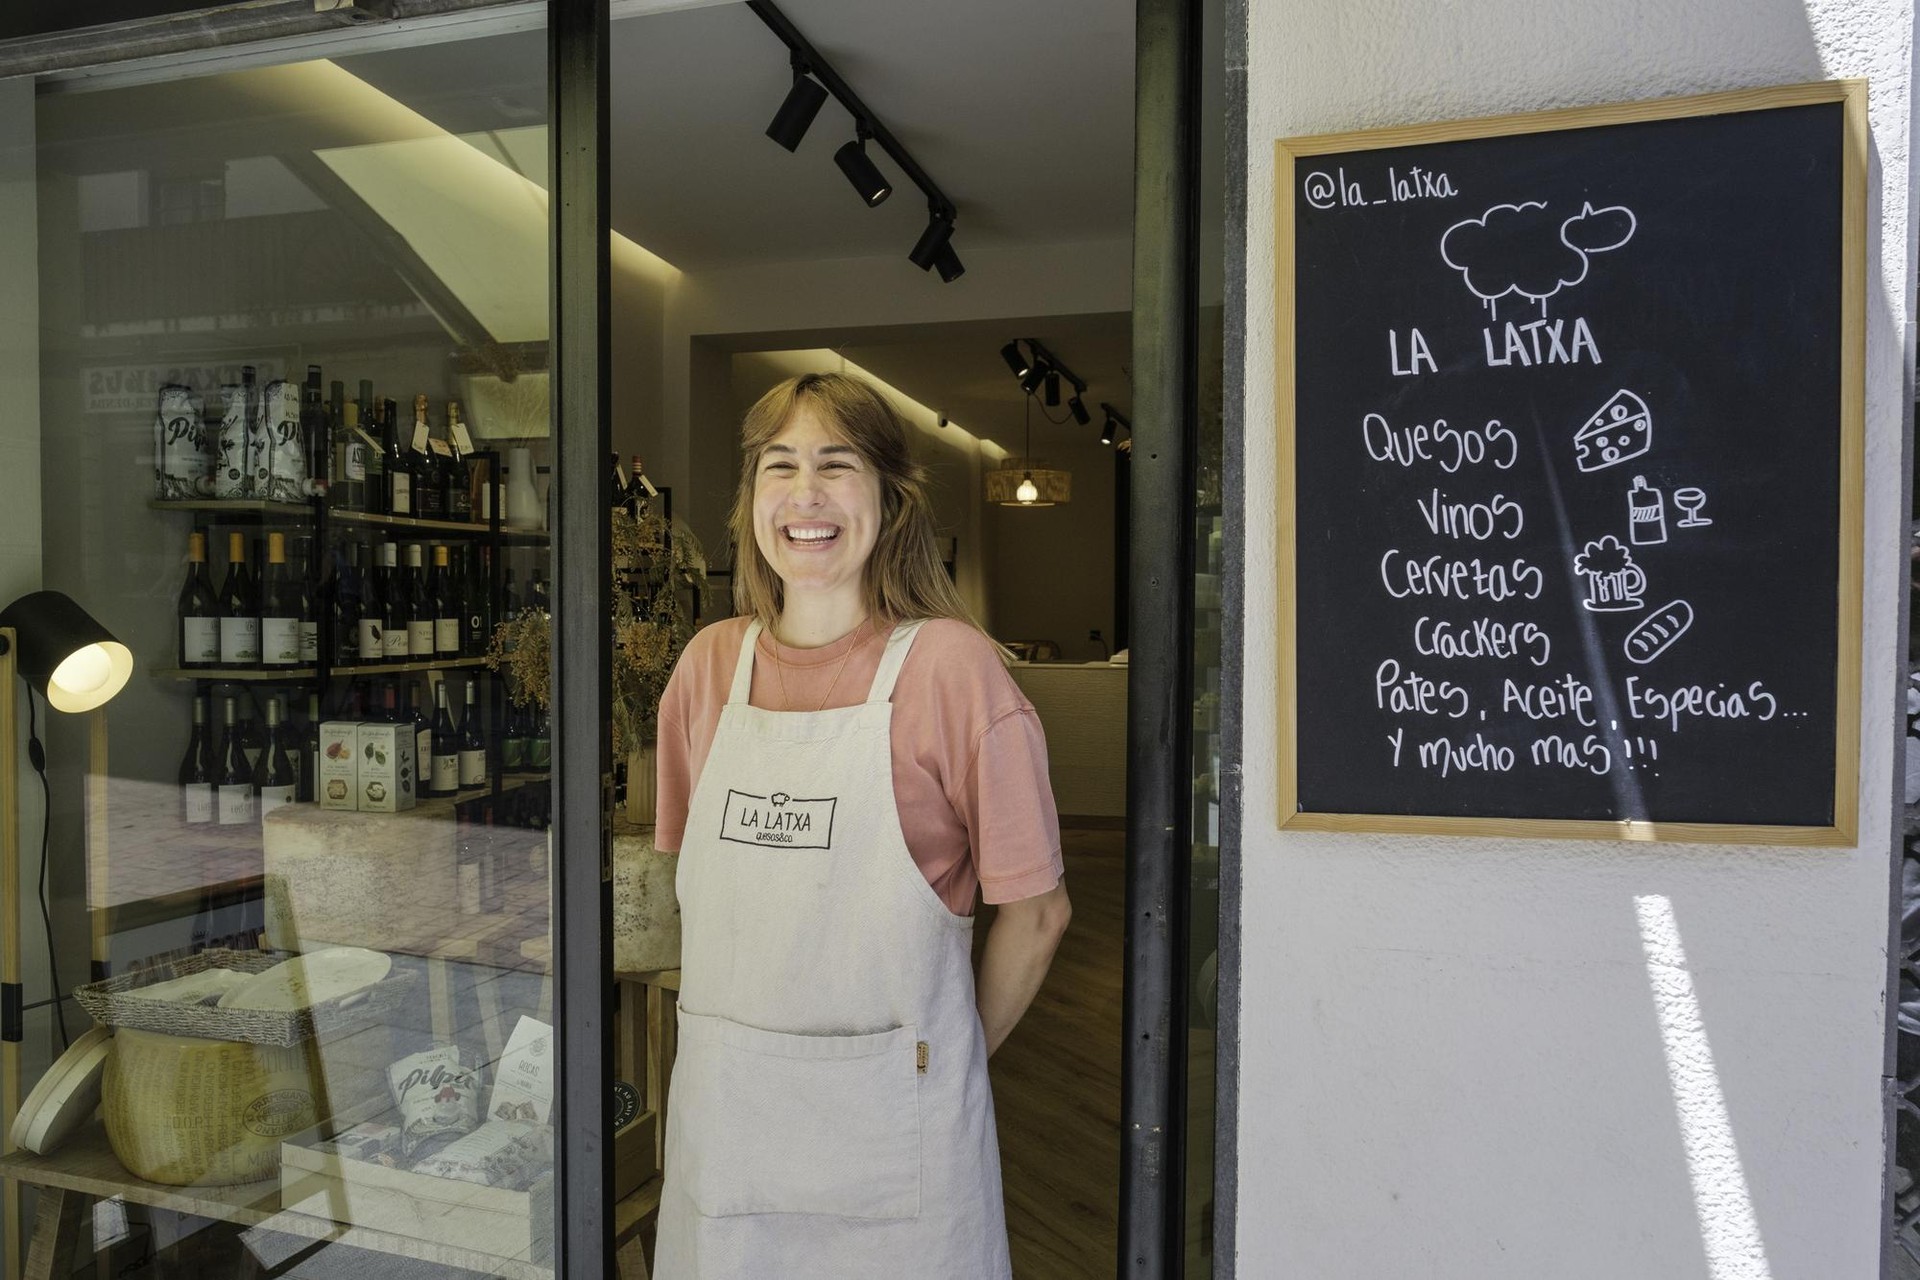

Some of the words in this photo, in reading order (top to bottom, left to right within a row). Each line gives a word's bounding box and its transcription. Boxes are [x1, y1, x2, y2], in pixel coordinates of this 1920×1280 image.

[1304, 166, 1458, 209] @la_latxa
[1389, 327, 1438, 375] LA
[1484, 317, 1603, 367] LATXA
[1363, 412, 1518, 472] Quesos
[1417, 488, 1524, 540] Vinos
[1381, 549, 1543, 602] Cervezas
[1414, 616, 1551, 666] Crackers
[1419, 733, 1516, 778] mucho
[740, 807, 759, 828] LA
[764, 811, 812, 832] LATXA
